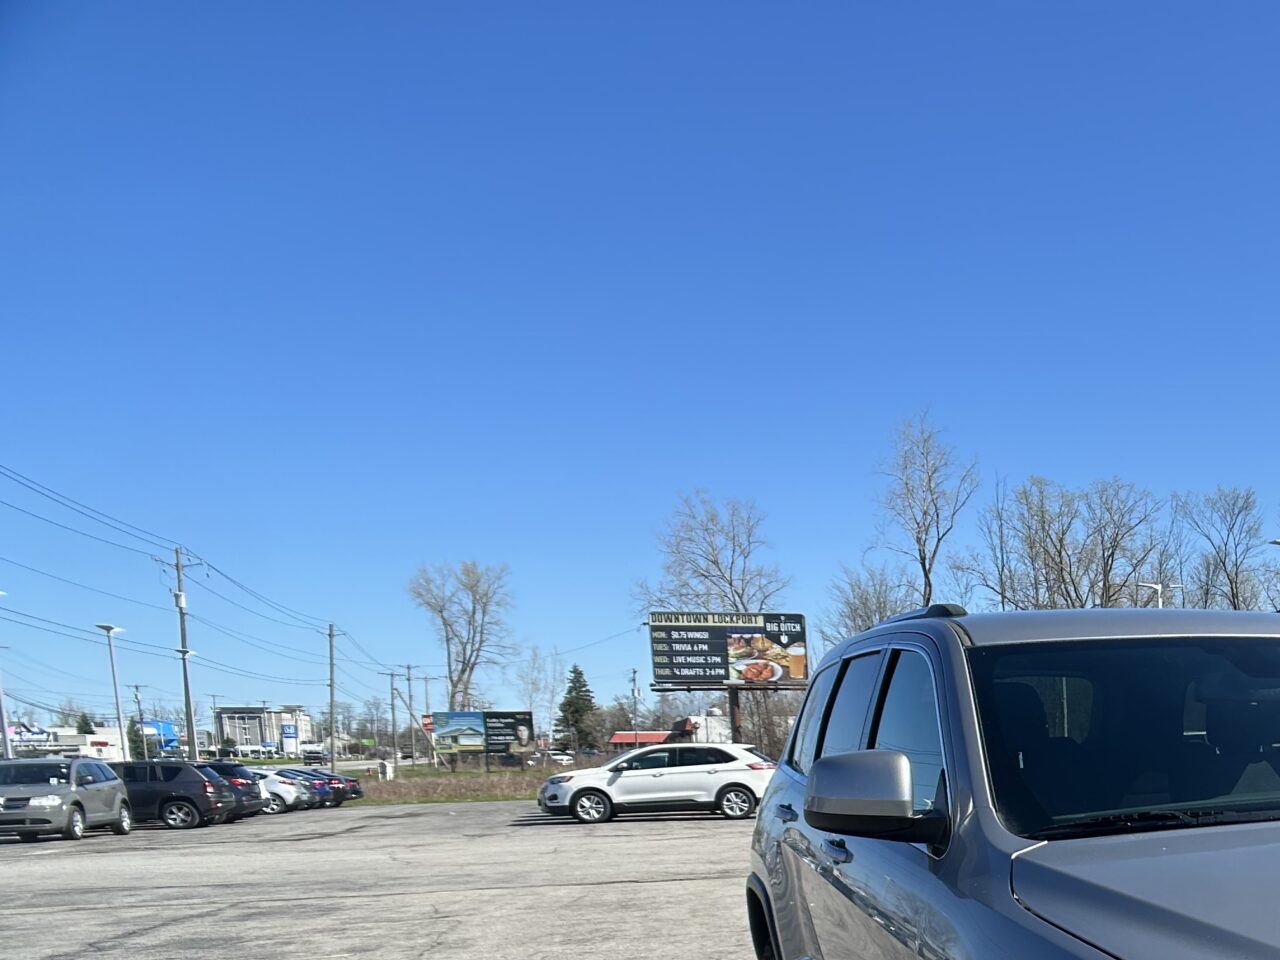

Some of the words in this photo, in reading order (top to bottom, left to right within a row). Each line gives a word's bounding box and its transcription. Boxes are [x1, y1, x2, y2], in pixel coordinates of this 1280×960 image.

[651, 613, 709, 623] DOWNTOWN
[712, 614, 758, 625] LOCKPORT
[766, 622, 779, 631] BIG
[780, 622, 801, 632] DITCH
[672, 643, 692, 651] TRIVIA
[698, 643, 708, 651] PM
[672, 655, 686, 663] LIVE
